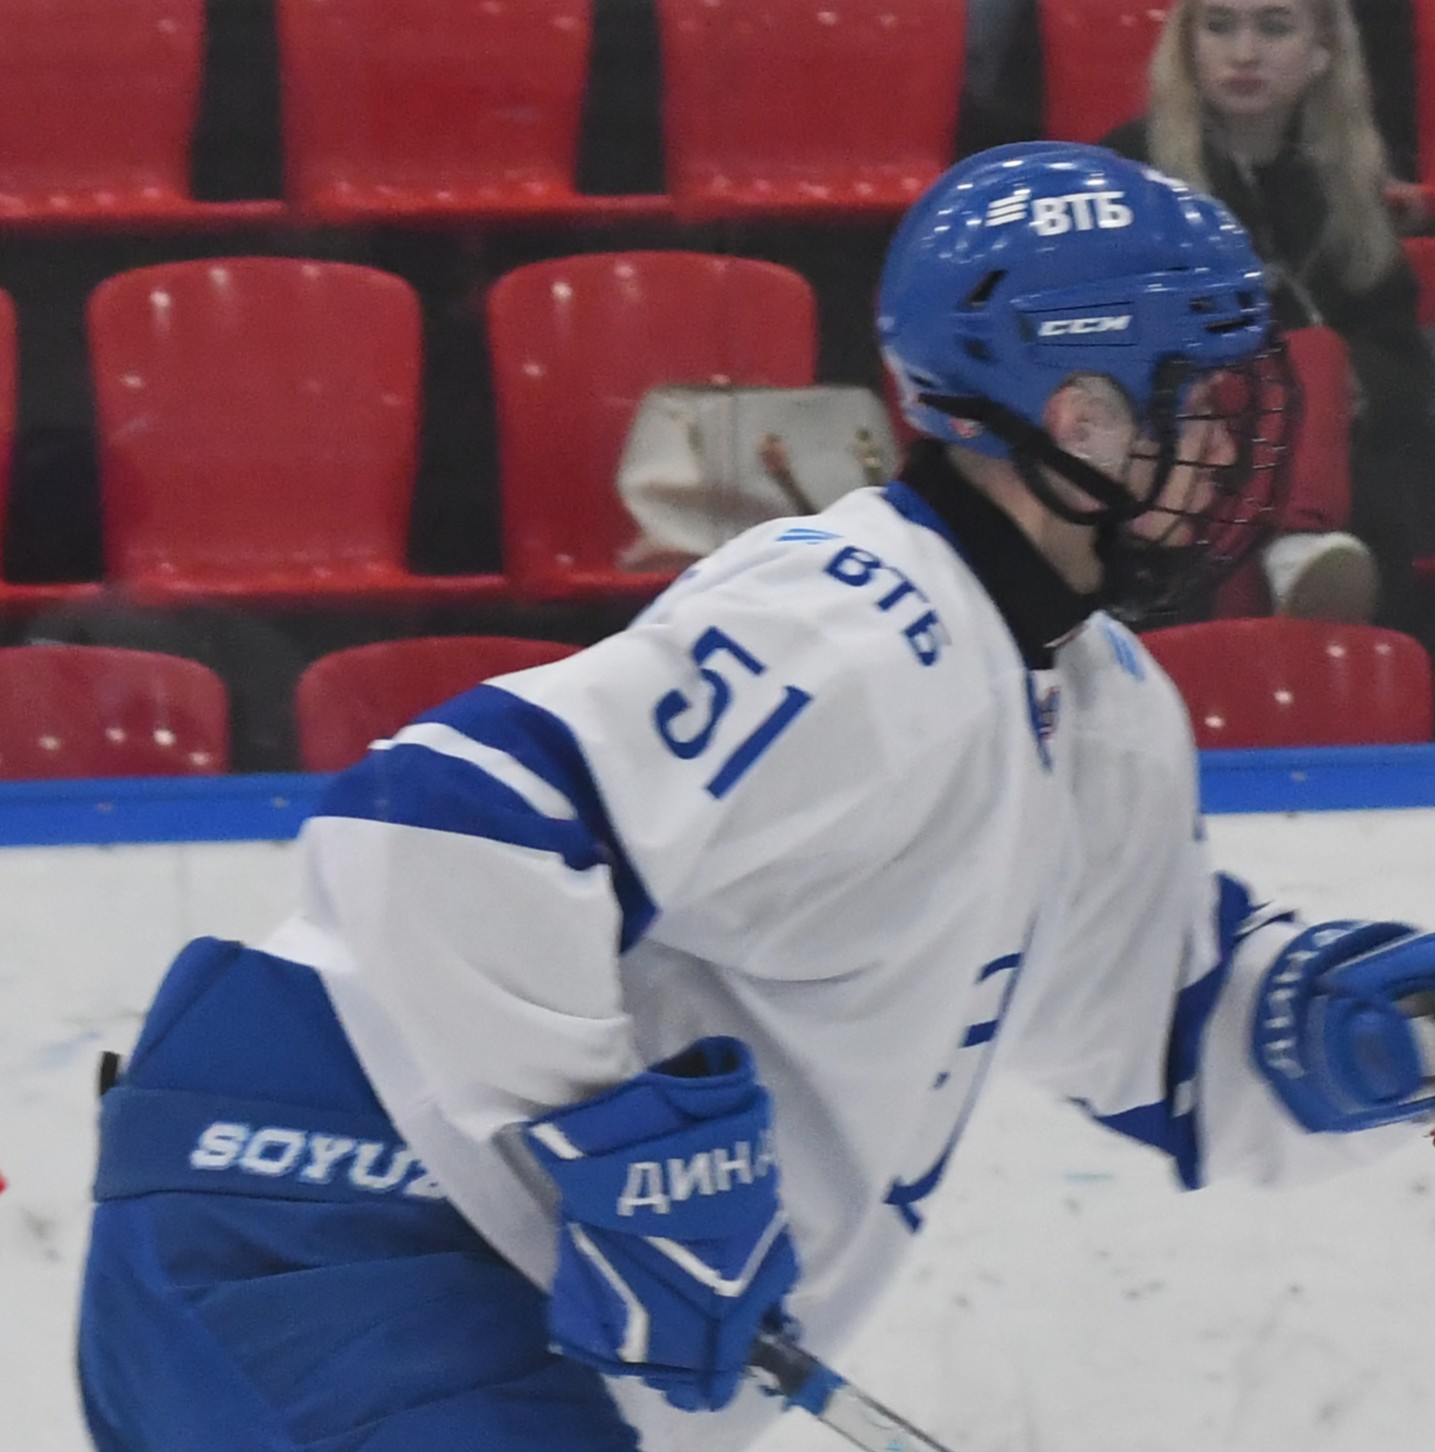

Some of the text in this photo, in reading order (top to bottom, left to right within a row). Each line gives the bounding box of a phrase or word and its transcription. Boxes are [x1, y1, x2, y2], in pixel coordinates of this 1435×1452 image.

[1029, 191, 1134, 237] ВТБ
[1038, 315, 1134, 337] CCM
[652, 626, 814, 801] 51
